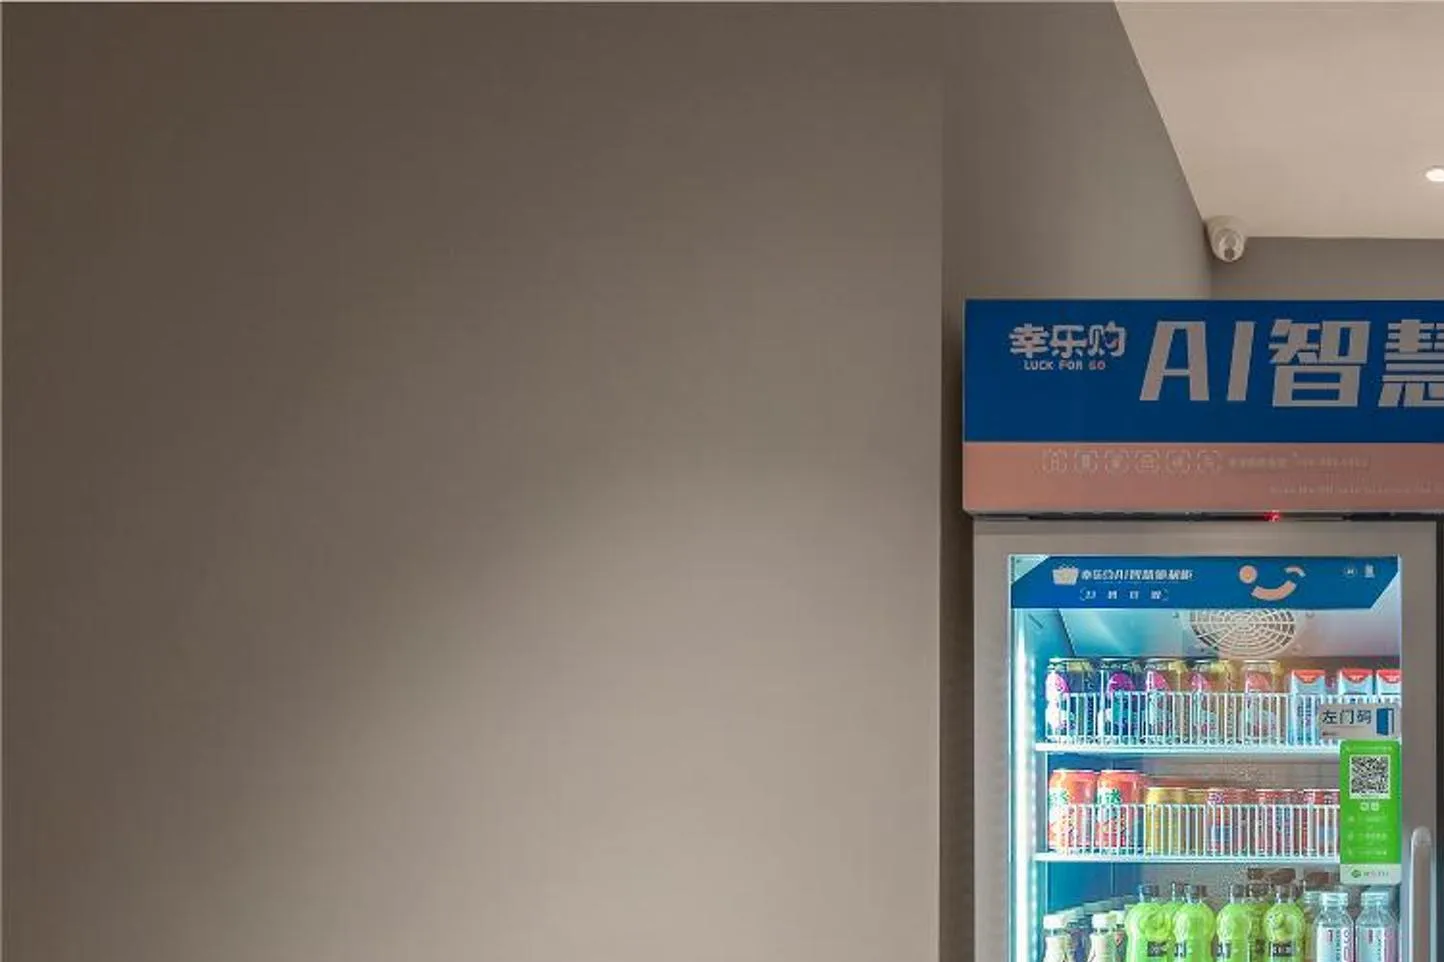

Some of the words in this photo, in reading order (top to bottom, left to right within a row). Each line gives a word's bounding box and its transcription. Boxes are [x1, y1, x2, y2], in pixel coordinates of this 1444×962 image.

[1008, 321, 1128, 358] 幸乐购
[1023, 359, 1054, 371] LUCK
[1059, 359, 1083, 371] FOR
[1088, 359, 1107, 371] GO
[1322, 709, 1373, 725] 左门码
